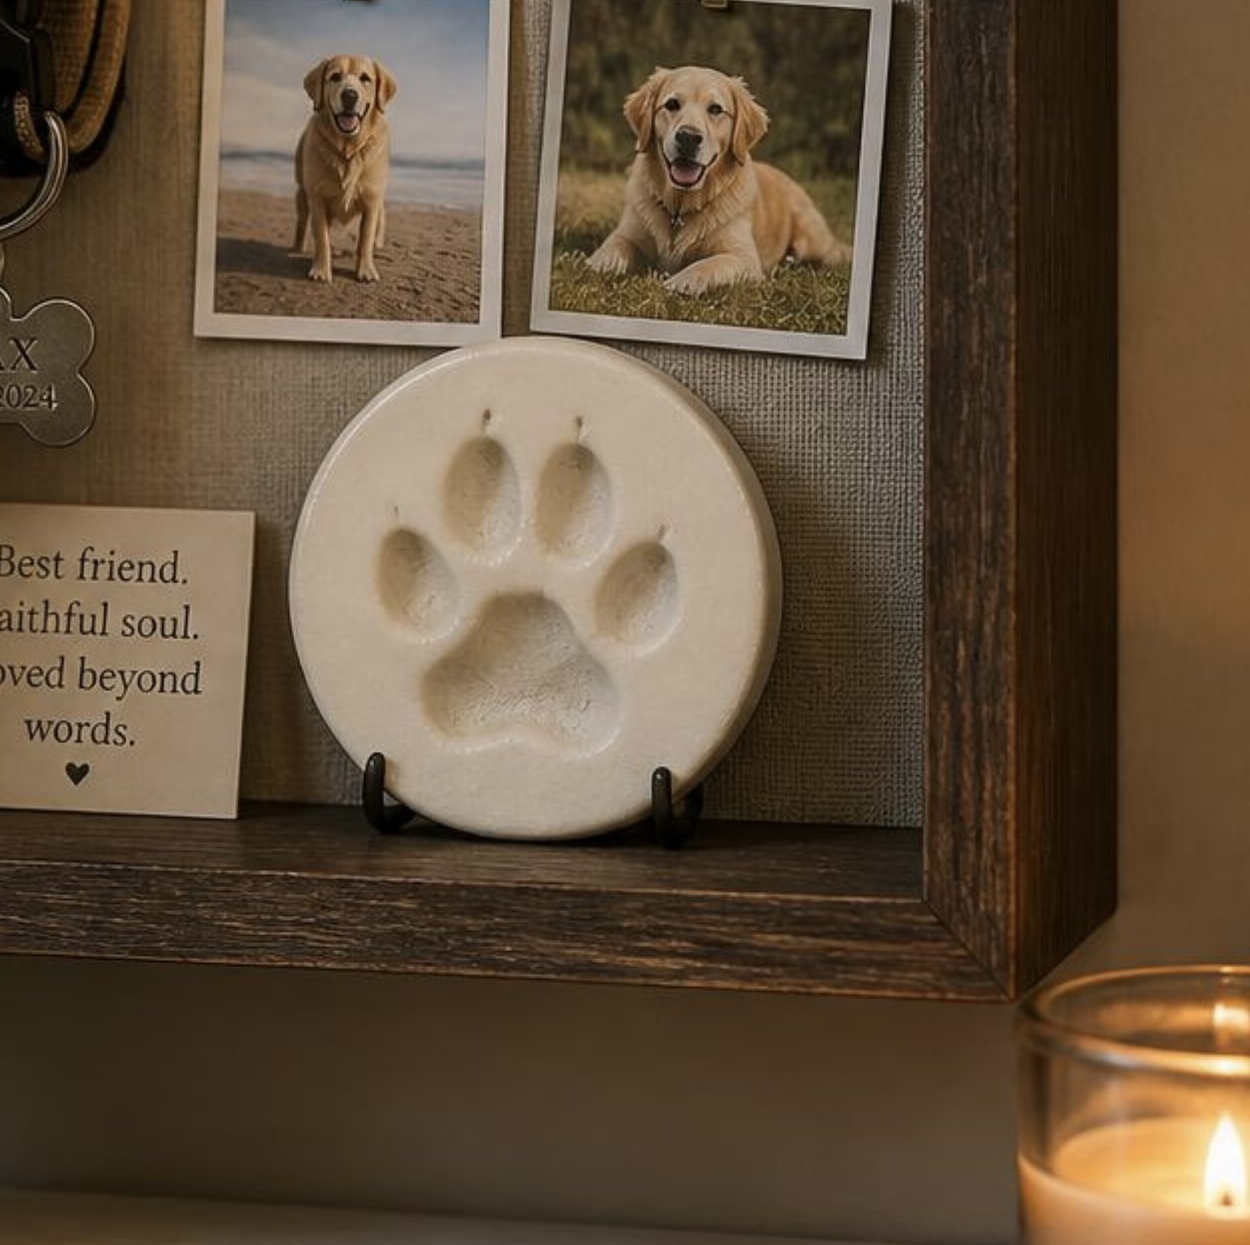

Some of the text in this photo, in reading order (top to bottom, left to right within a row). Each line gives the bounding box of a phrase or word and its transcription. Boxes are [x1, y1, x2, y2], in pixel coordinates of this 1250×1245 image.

[76, 546, 190, 586] friend.
[120, 604, 200, 640] soul.
[77, 655, 203, 701] beyond
[24, 711, 137, 747] words.
